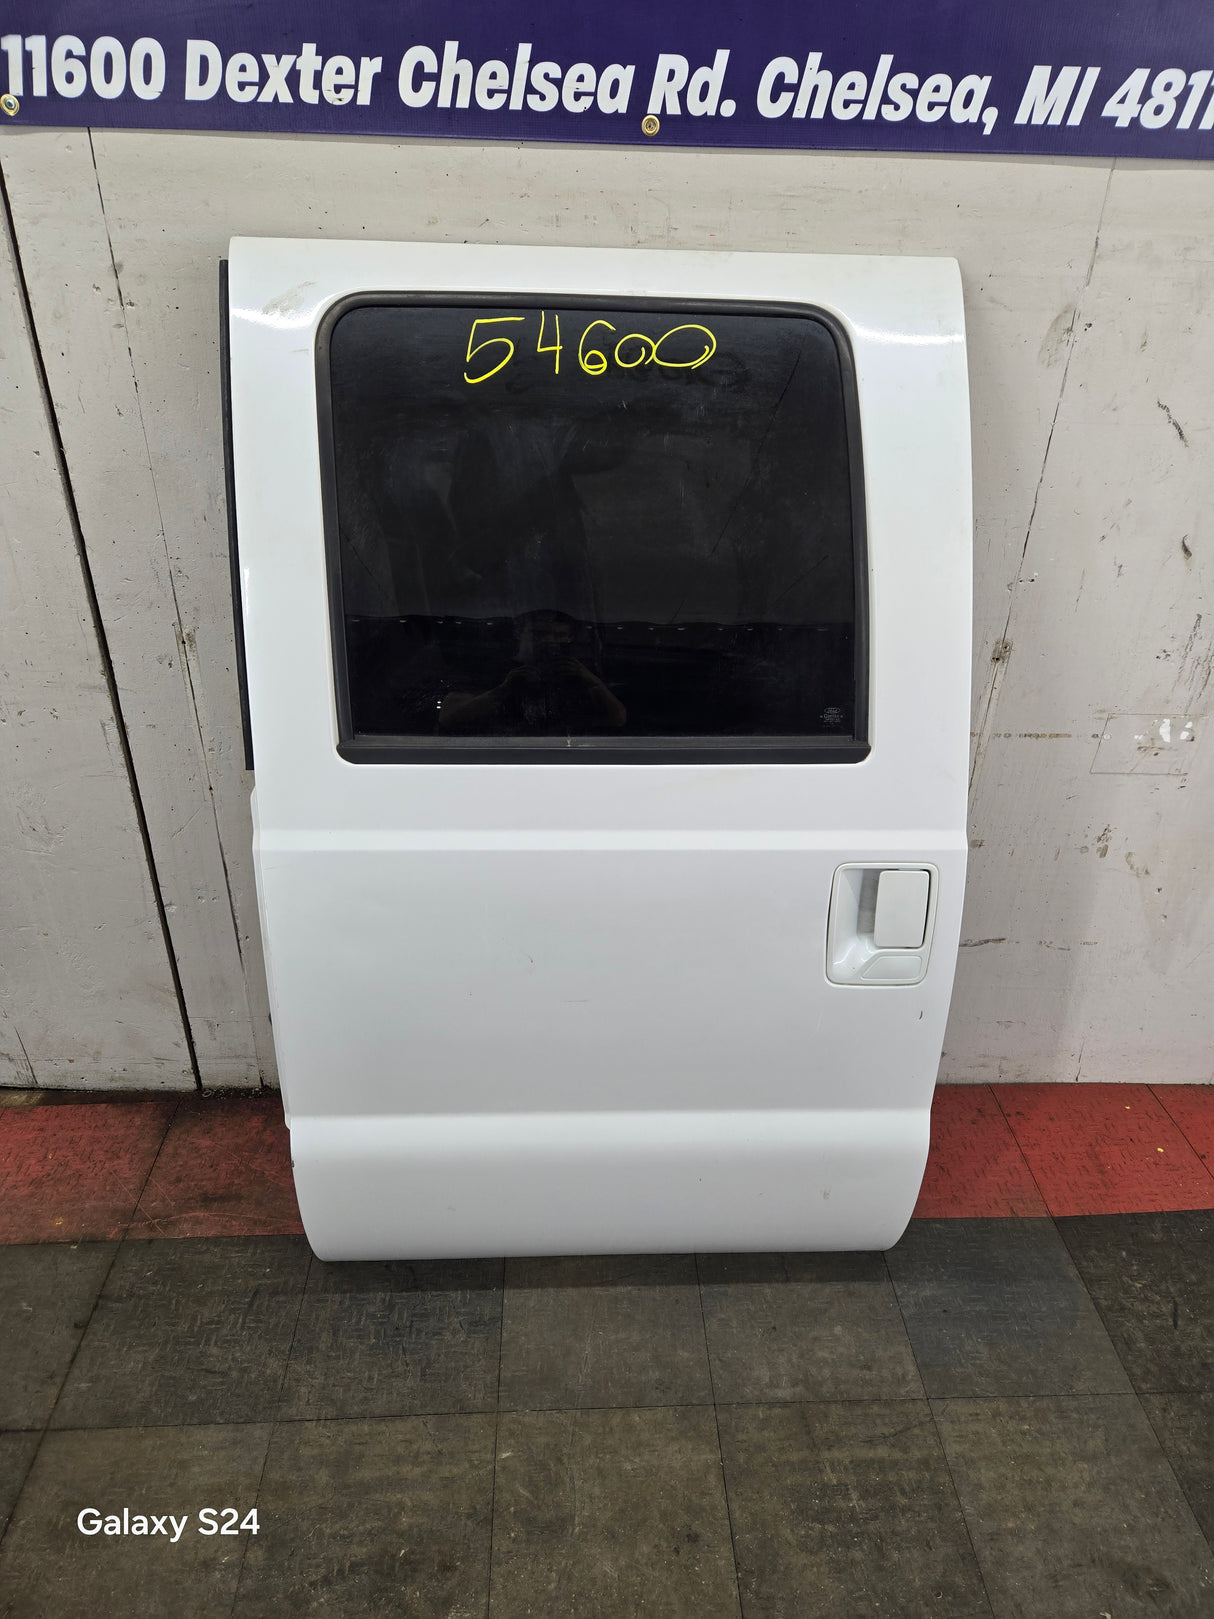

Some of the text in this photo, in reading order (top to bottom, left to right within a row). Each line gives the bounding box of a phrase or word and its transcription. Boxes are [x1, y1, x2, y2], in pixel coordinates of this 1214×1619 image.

[1, 34, 166, 100] 11600
[185, 39, 383, 106] Dexter
[399, 40, 636, 113] Chelsea
[646, 48, 737, 117] Rd.
[756, 51, 999, 135] Chelsea,
[1013, 65, 1102, 126] MI
[464, 311, 717, 384] 54600
